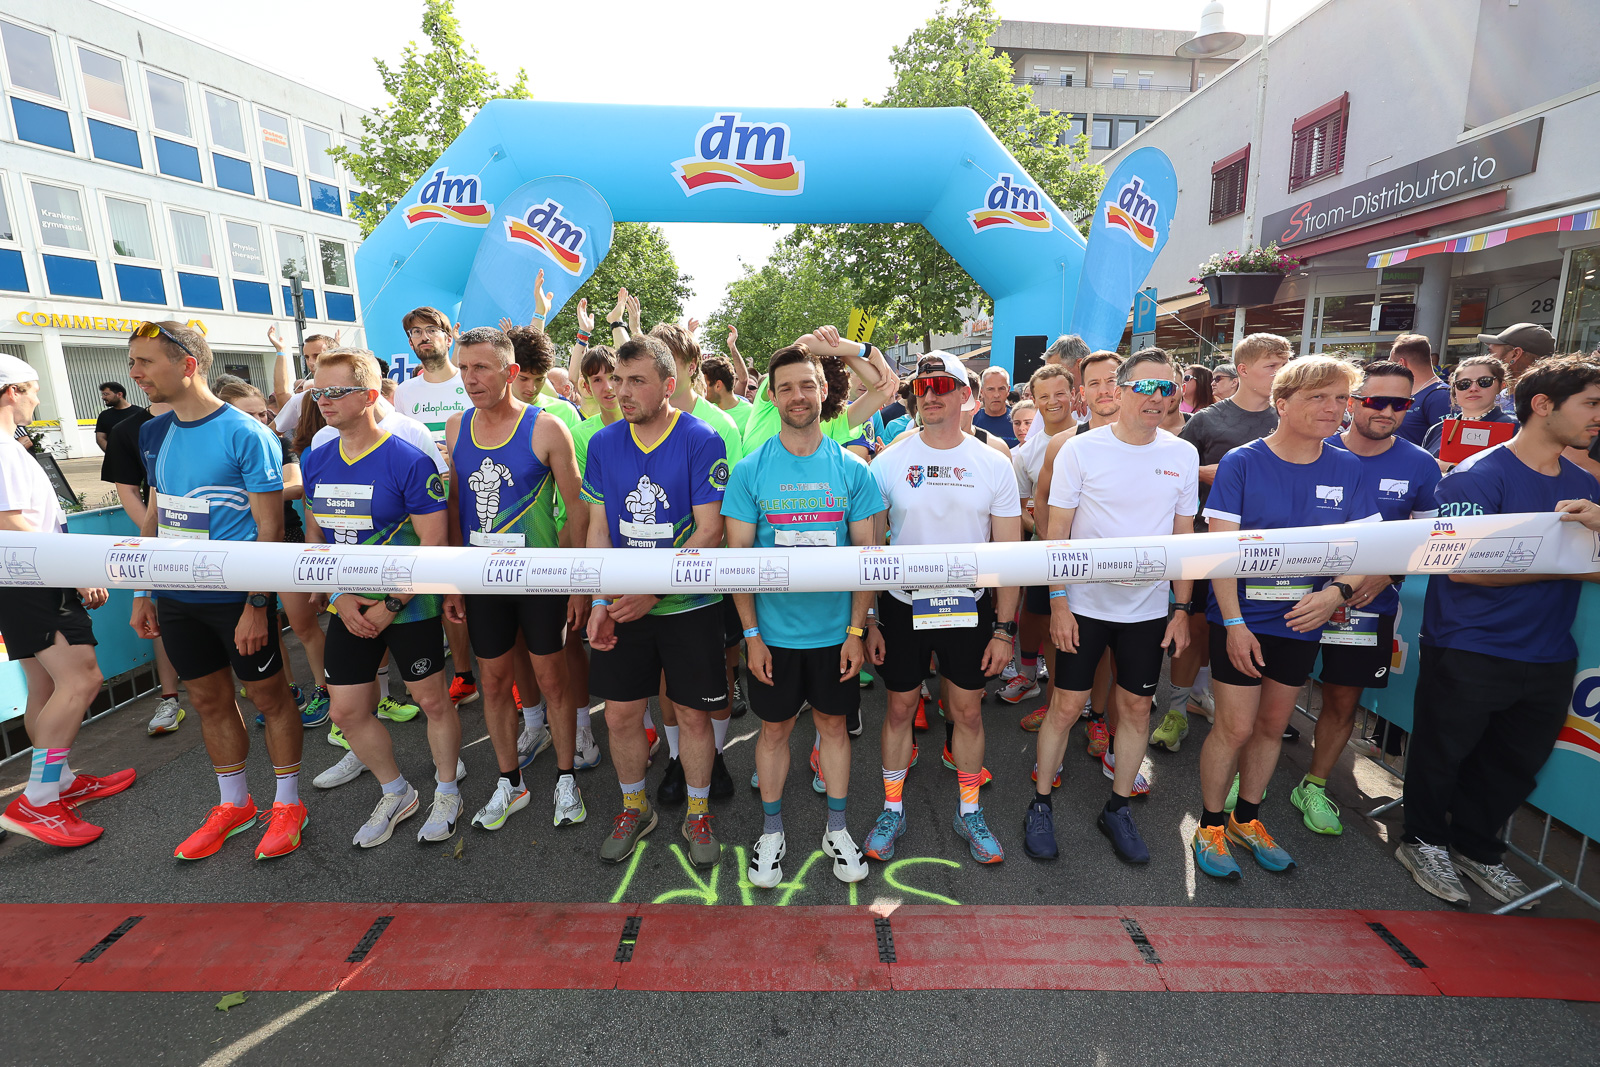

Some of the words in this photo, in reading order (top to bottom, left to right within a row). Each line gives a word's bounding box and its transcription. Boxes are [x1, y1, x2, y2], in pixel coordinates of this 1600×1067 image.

[700, 115, 785, 160] dm
[420, 171, 478, 204] dm
[988, 177, 1039, 210] dm
[1119, 180, 1157, 226] dm
[1281, 156, 1497, 243] Strom-Distributor.io
[41, 209, 80, 221] Kranken-
[42, 220, 83, 232] gymnastik
[527, 203, 583, 251] dm
[233, 242, 257, 251] Physio-
[232, 251, 260, 261] therapie
[1530, 298, 1554, 313] 28
[1138, 296, 1151, 329] P
[326, 499, 355, 508] Sascha
[760, 489, 848, 510] ELEKTROLÜTE
[1440, 502, 1484, 517] 2026
[165, 510, 188, 521] Marco
[792, 514, 819, 522] AKTIV
[1433, 521, 1453, 530] dm
[627, 538, 657, 548] Jeremy
[1430, 543, 1466, 552] FIRMEN
[109, 553, 148, 563] FIRMEN
[1052, 552, 1088, 561] FIRMEN
[1244, 548, 1280, 557] FIRMEN
[1469, 551, 1505, 559] HOMBURG
[300, 557, 338, 565] FIRMEN
[864, 557, 900, 565] FIRMEN
[1097, 561, 1133, 569] HOMBURG
[1241, 559, 1279, 572] LAUF
[1286, 557, 1322, 565] HOMBURG
[1424, 554, 1461, 566] LAUF
[109, 565, 145, 579] LAUF
[153, 564, 189, 572] HOMBURG
[342, 566, 379, 575] HOMBURG
[908, 565, 944, 573] HOMBURG
[1053, 564, 1089, 578] LAUF
[298, 567, 334, 581] LAUF
[487, 569, 523, 582] LAUF
[676, 569, 711, 583] LAUF
[865, 567, 900, 581] LAUF
[930, 597, 959, 607] Martin
